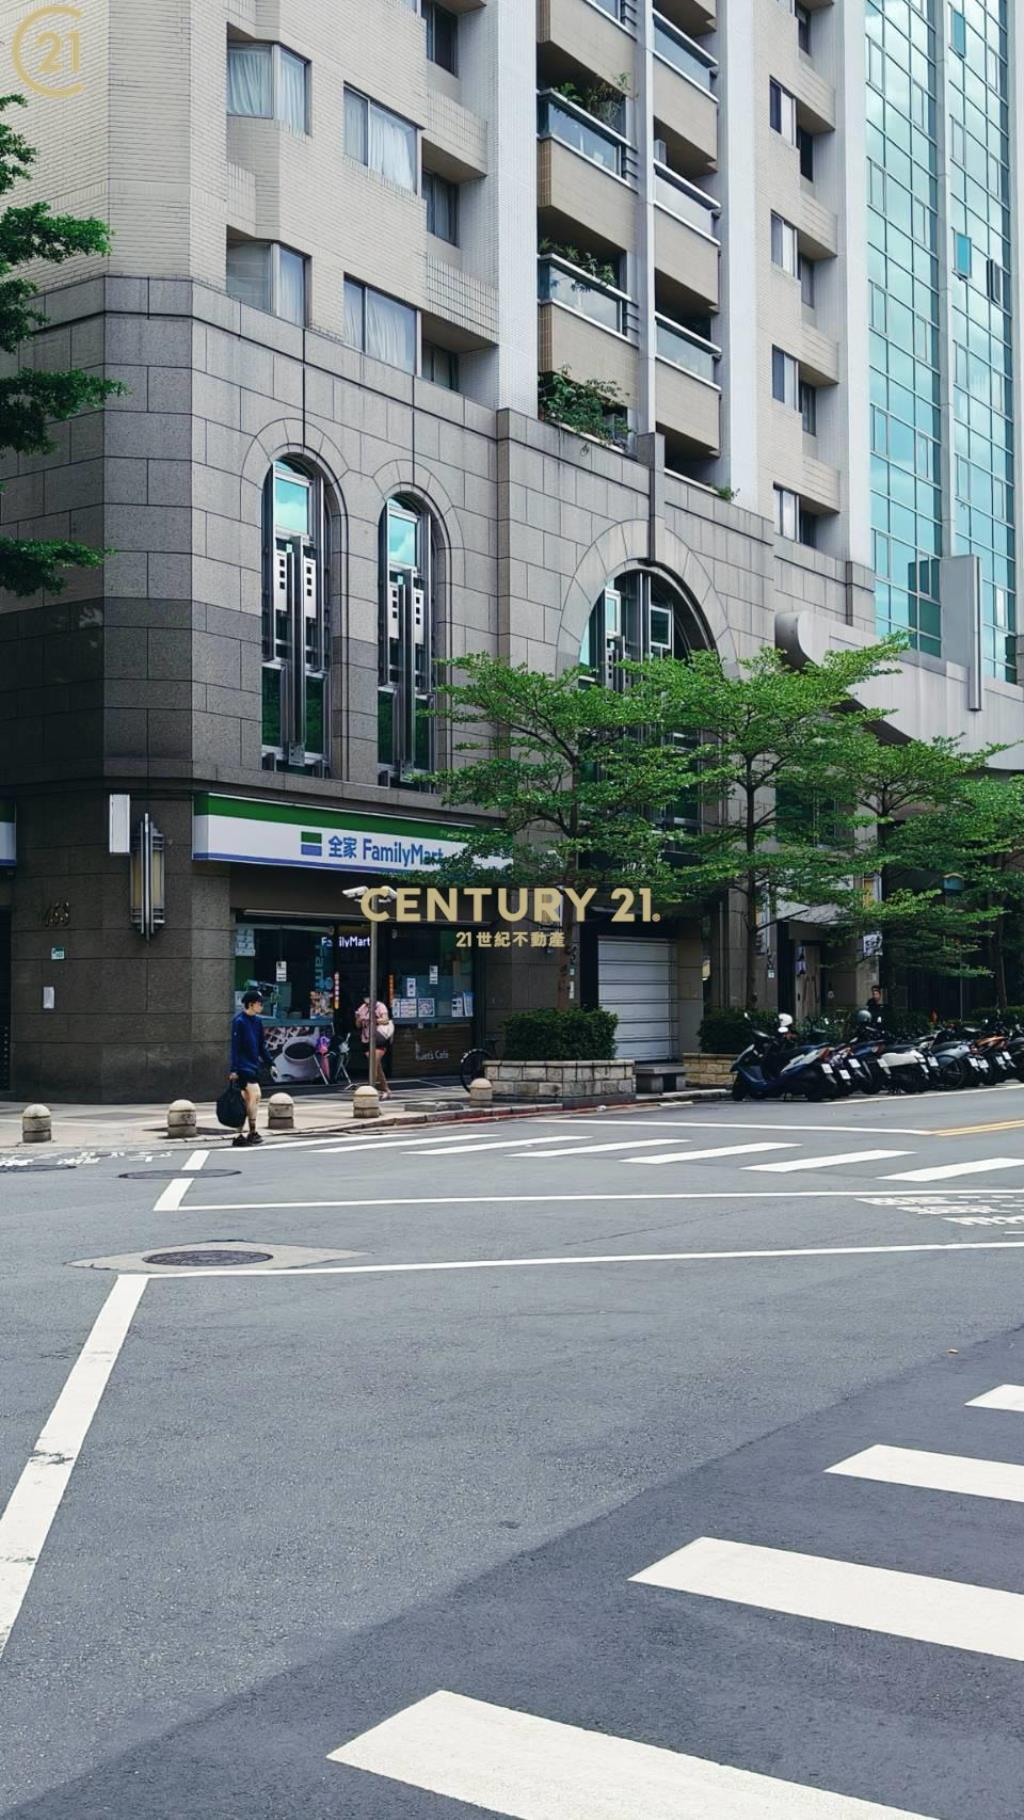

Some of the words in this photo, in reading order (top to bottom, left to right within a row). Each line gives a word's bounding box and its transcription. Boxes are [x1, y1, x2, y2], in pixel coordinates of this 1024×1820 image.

[328, 835, 357, 858] 全家
[363, 838, 444, 867] FamilyMart
[321, 936, 371, 948] FailyMart
